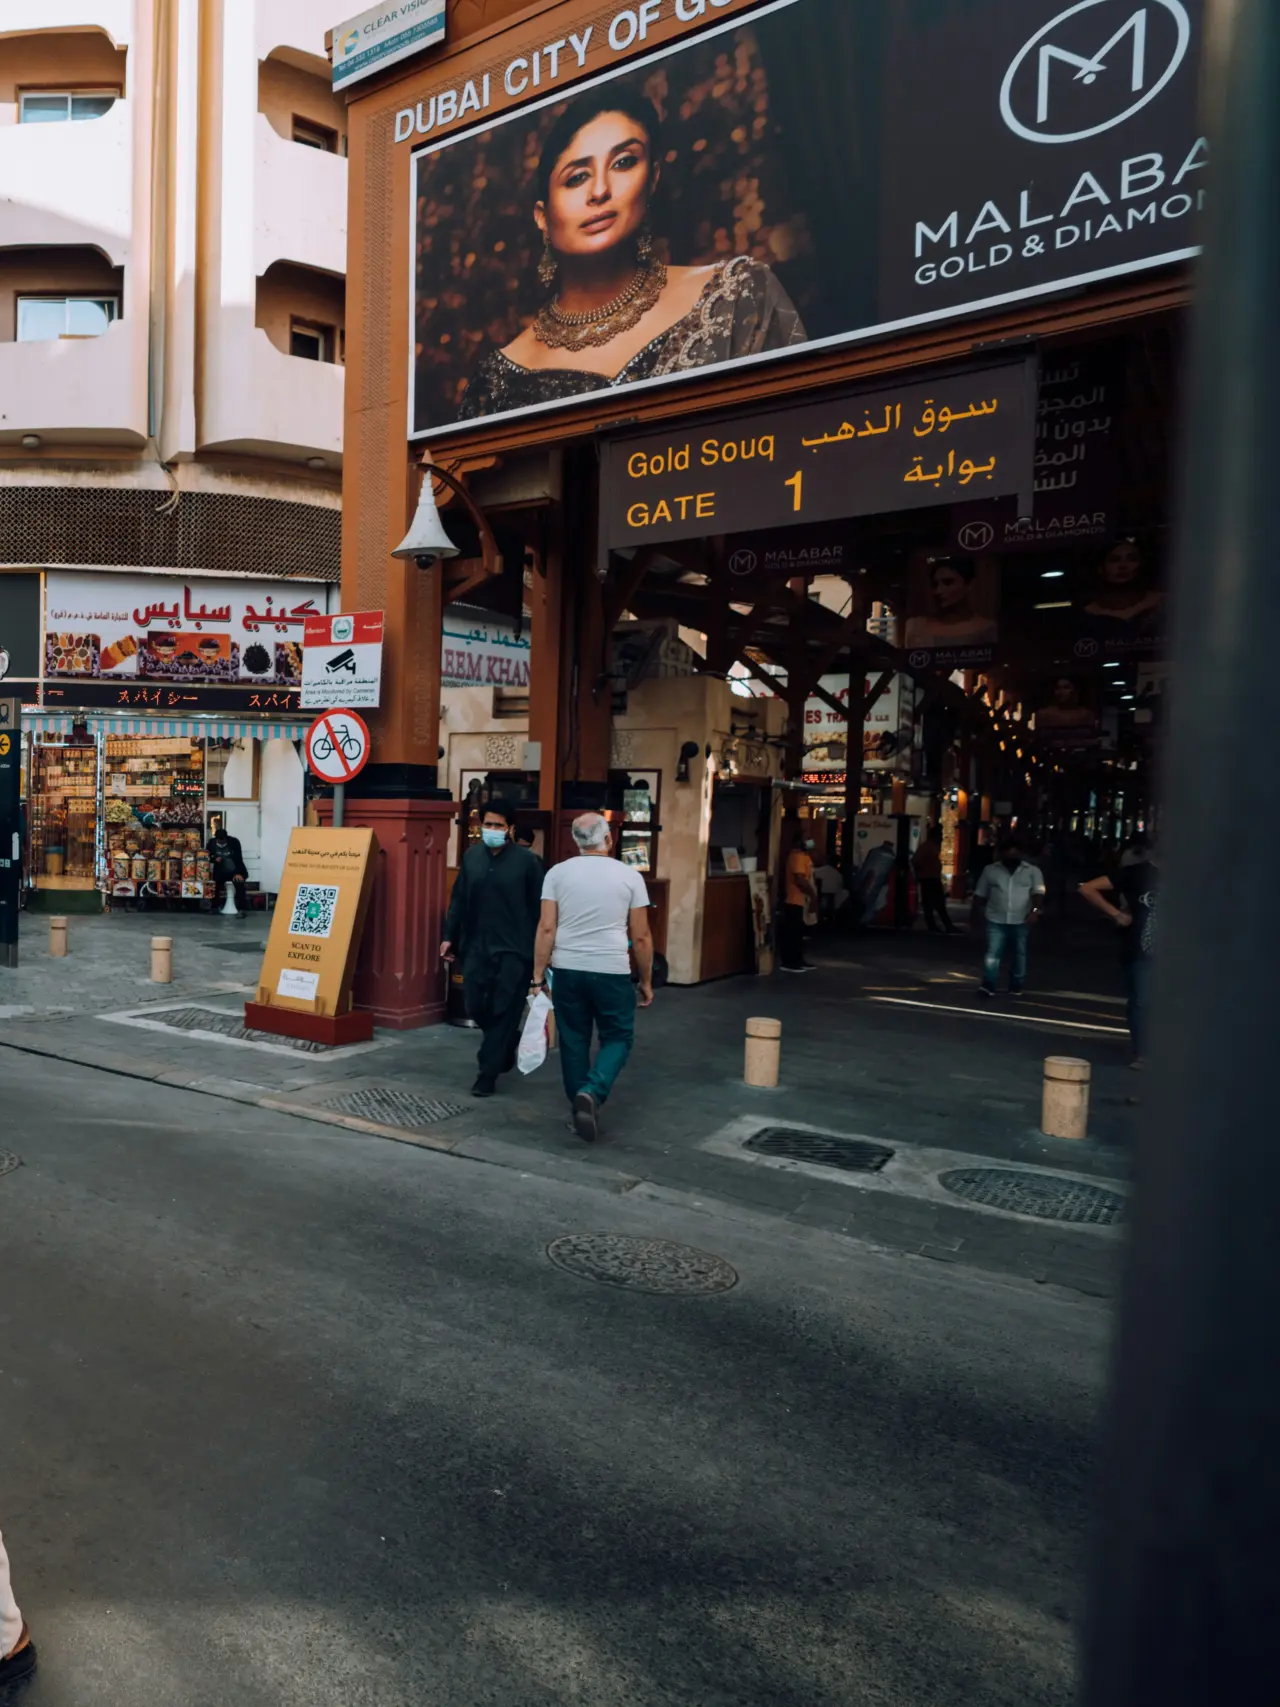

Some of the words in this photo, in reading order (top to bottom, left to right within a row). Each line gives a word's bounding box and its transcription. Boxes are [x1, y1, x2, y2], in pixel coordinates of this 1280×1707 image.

[363, 10, 398, 34] CLEAR
[394, 74, 490, 143] DUBAI
[504, 27, 592, 96] CITY
[608, 0, 661, 50] OF
[914, 244, 1012, 285] GOLD
[1022, 235, 1045, 257] &
[801, 407, 902, 453] الذهب
[913, 399, 997, 437] سوق
[627, 445, 690, 478] Gold
[701, 434, 775, 466] Souq
[903, 449, 996, 488] بوابة
[627, 492, 716, 528] GATE
[784, 470, 804, 512] 1
[765, 546, 843, 562] MALABAR
[132, 584, 232, 629] سبايس
[242, 596, 321, 632] كينج
[441, 648, 483, 682] EEM
[287, 951, 321, 962] EXPLORE
[291, 941, 311, 951] SCAN
[312, 943, 322, 952] TO
